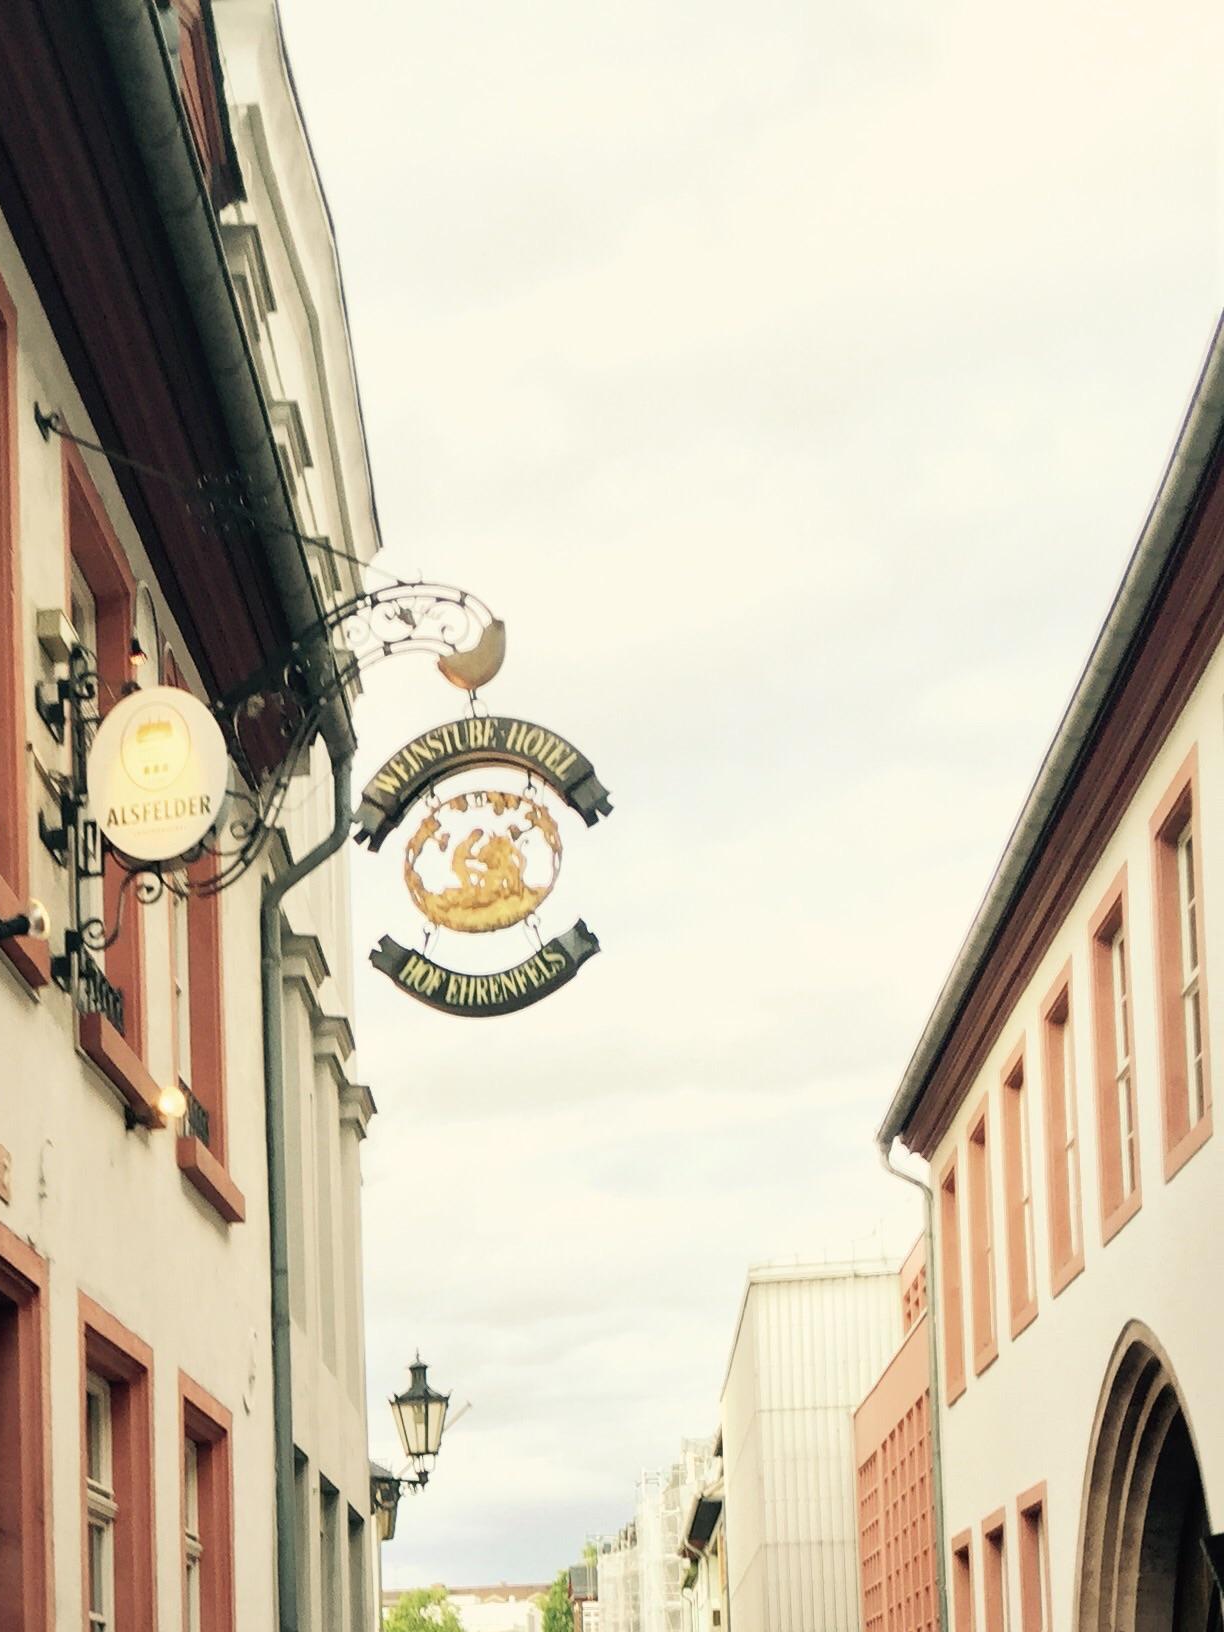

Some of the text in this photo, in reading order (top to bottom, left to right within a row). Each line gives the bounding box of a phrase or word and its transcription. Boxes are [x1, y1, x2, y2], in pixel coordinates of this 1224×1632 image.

[376, 718, 577, 795] WEINSTUBE HOTEL
[107, 794, 212, 829] ALSFELDER
[398, 948, 566, 1006] HOF EHRENFELS
